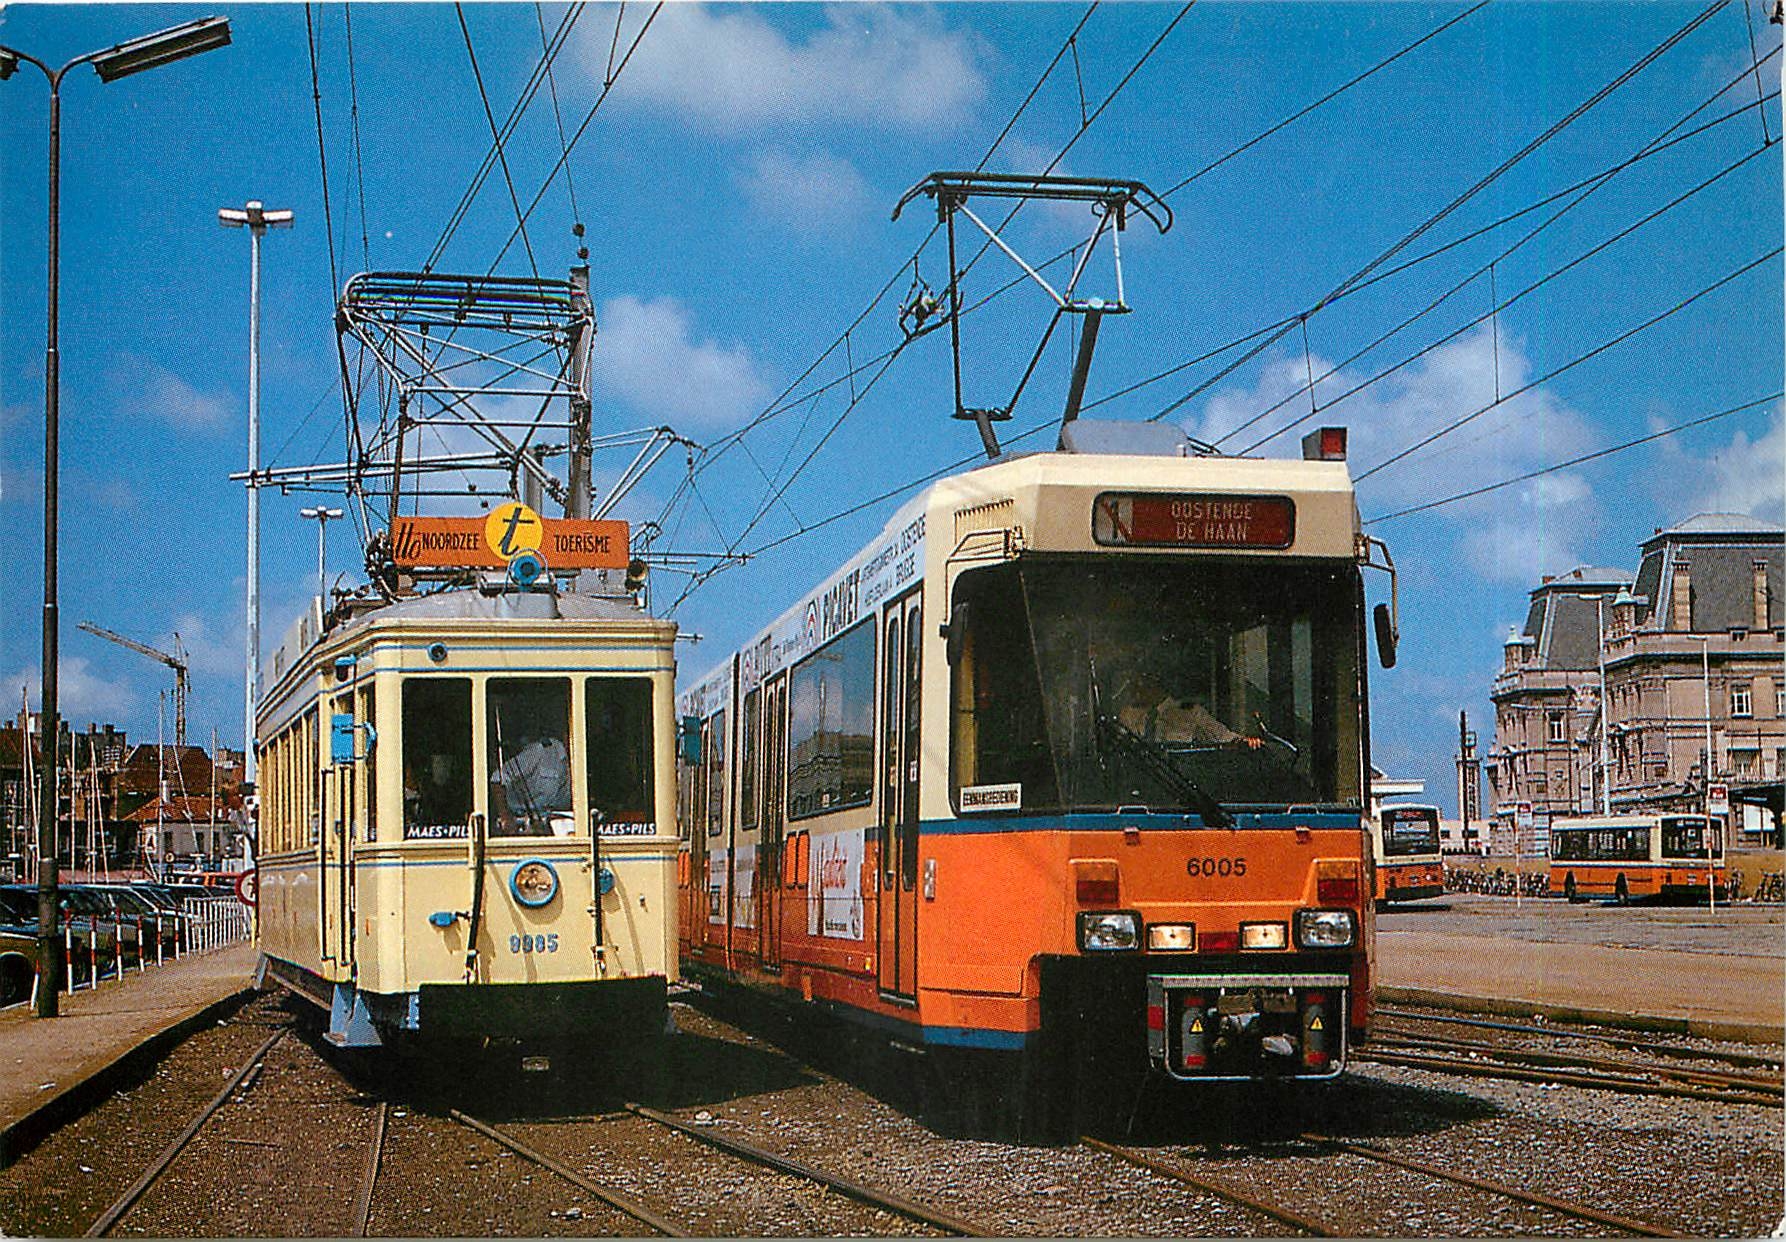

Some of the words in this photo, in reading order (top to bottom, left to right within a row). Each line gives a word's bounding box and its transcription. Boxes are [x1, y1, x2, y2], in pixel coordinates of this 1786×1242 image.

[1171, 501, 1253, 520] OOSTENDE
[498, 507, 534, 556] t
[1176, 522, 1195, 540] DE
[1204, 522, 1248, 541] HAAN
[422, 532, 479, 551] NOORDZEE
[1187, 858, 1247, 877] 6005
[510, 934, 558, 953] 9985
